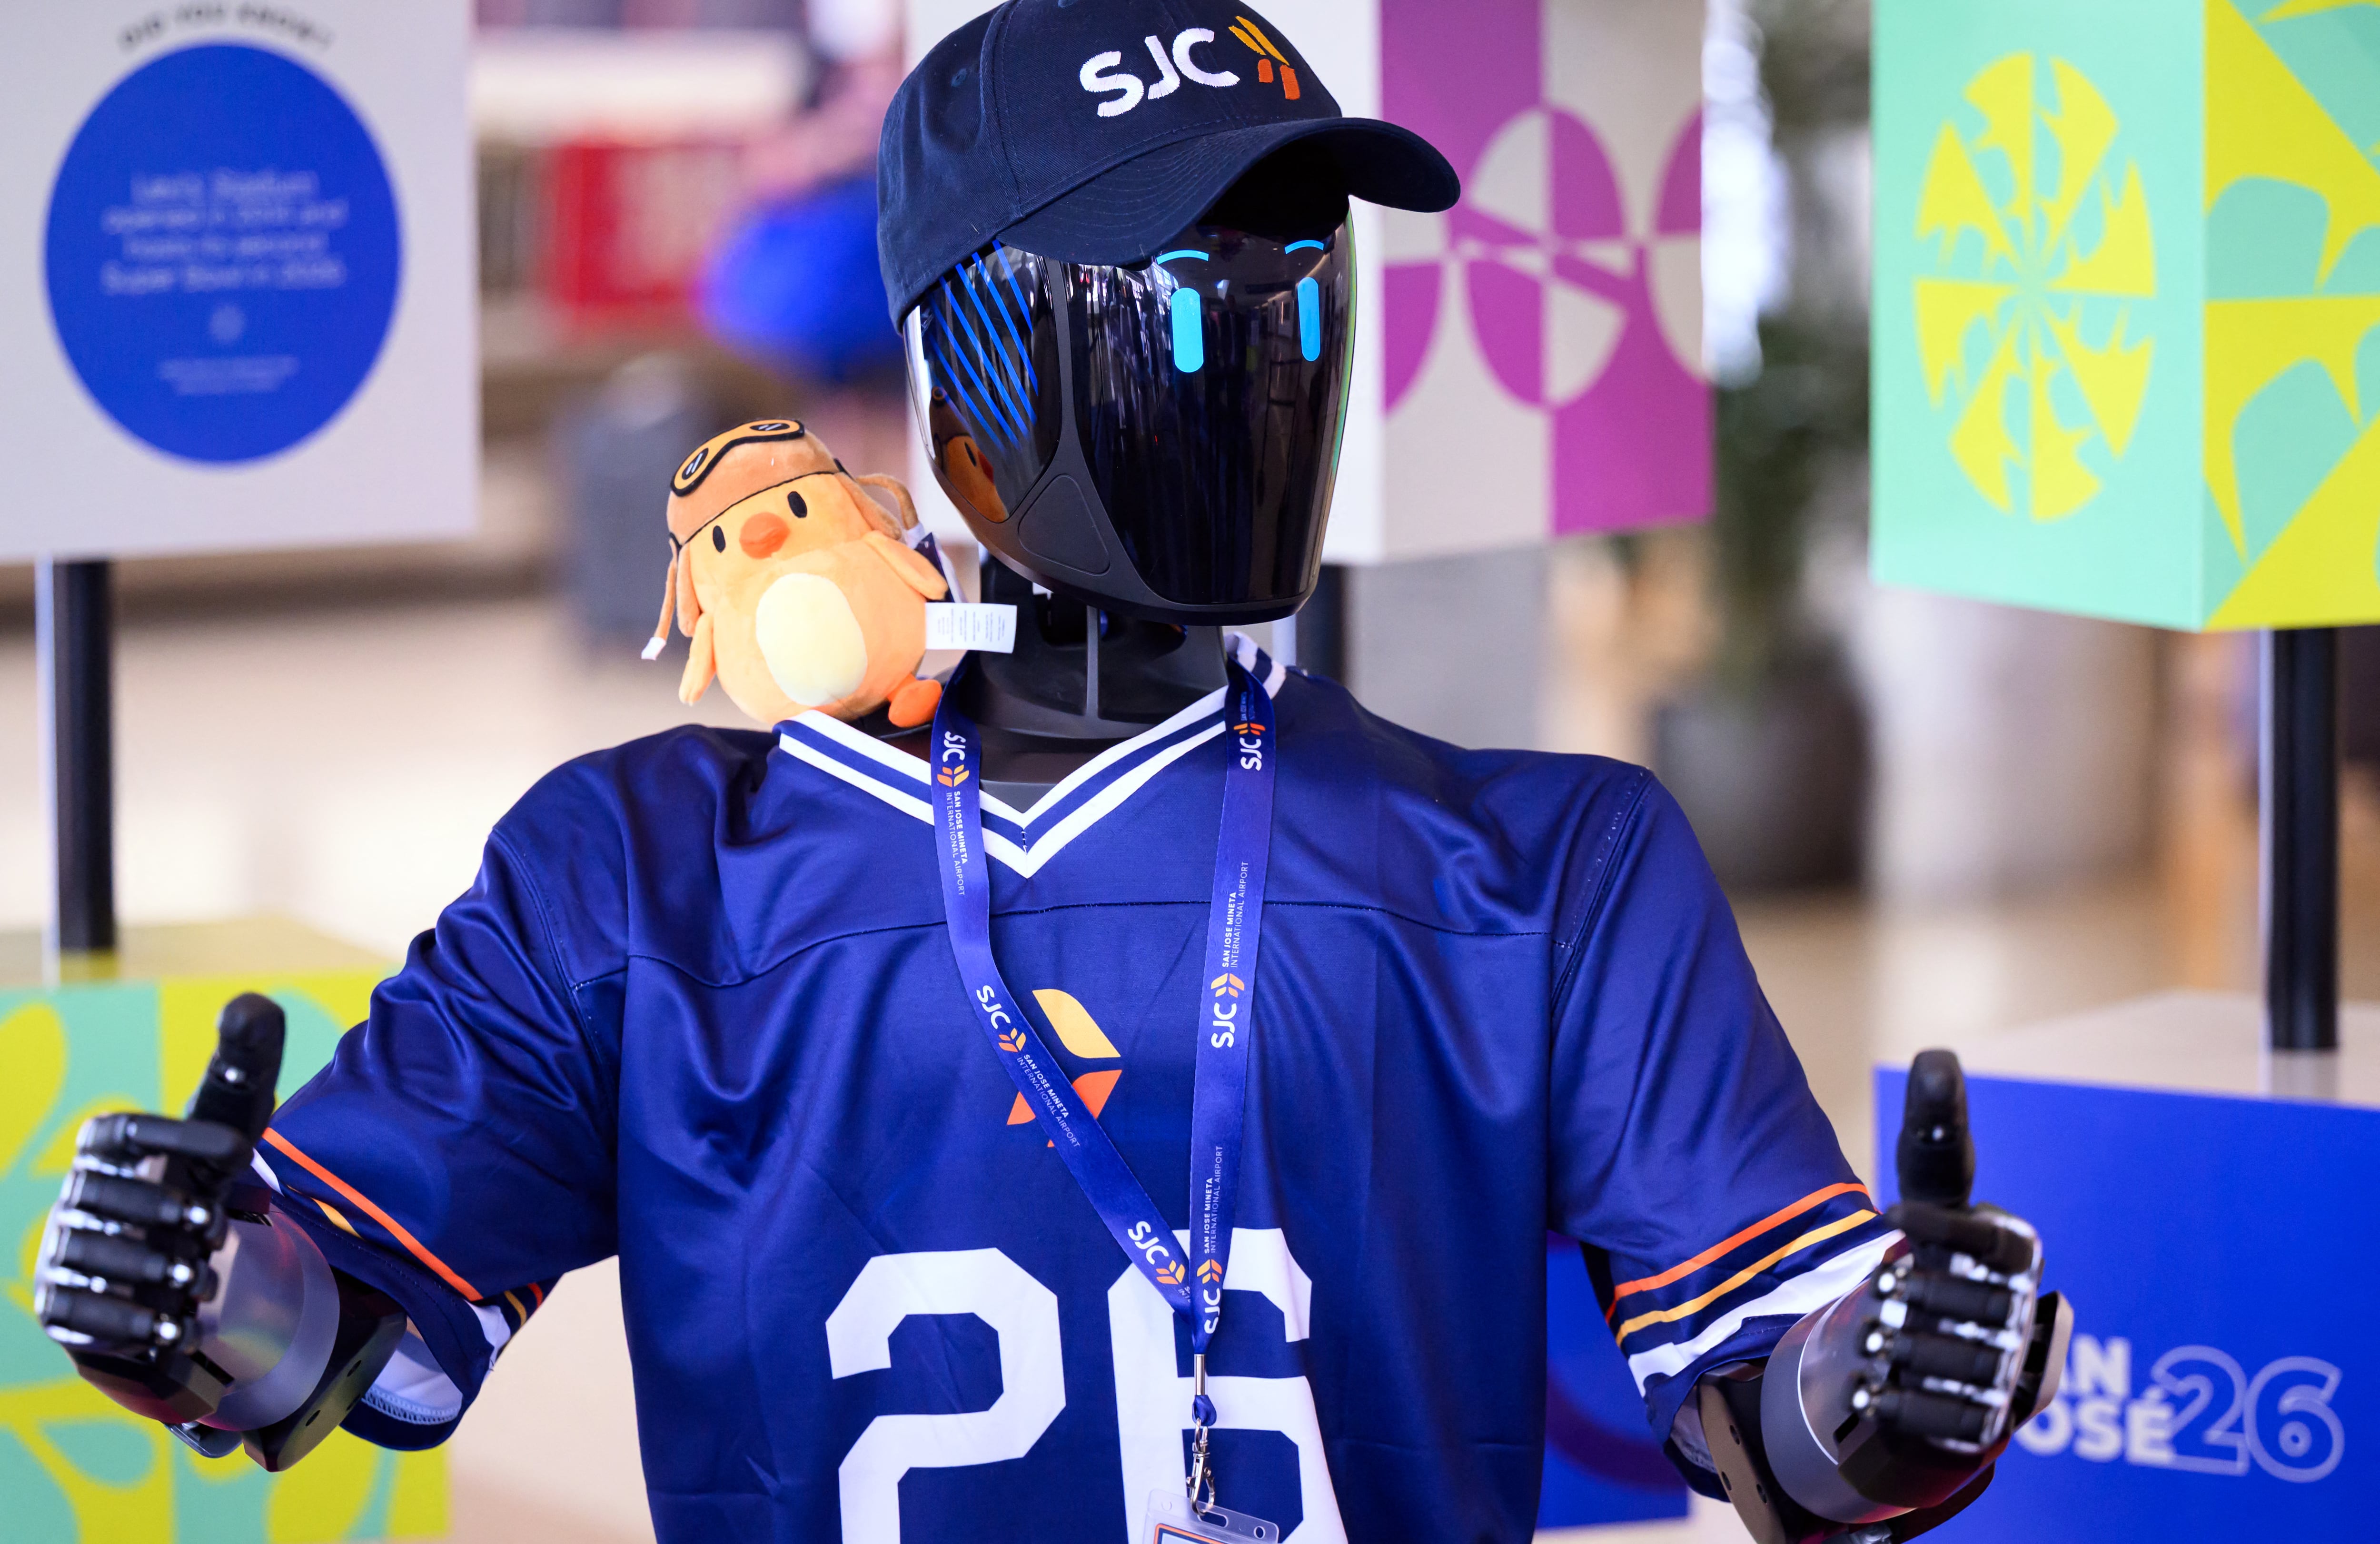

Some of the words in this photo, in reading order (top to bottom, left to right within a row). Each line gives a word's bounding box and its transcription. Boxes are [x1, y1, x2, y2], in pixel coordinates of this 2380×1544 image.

[1080, 28, 1240, 117] SJC
[942, 731, 967, 762] SJC
[1239, 737, 1262, 772] SJC
[955, 809, 963, 830] JOSE
[946, 792, 960, 858] INTERNATIONAL
[953, 860, 965, 896] AIRPORT
[957, 831, 968, 864] MINETA
[1226, 891, 1237, 925] MINETA
[1230, 900, 1244, 968] INTERNATIONAL
[1238, 861, 1249, 898] AIRPORT
[1222, 946, 1230, 968] SAN
[1224, 927, 1233, 951] JOSE
[976, 985, 1011, 1029] SJC
[1210, 1002, 1237, 1048] SJC
[1016, 1057, 1057, 1116] INTERNATIONAL
[1055, 1117, 1081, 1147] AIRPORT
[1023, 1054, 1037, 1070] SAN
[1034, 1070, 1050, 1089] JOSE
[1047, 1089, 1069, 1118] MINETA
[1214, 1146, 1223, 1183] AIRPORT
[1205, 1178, 1213, 1211] MINETA
[1210, 1186, 1220, 1253] INTERNATIONAL
[1128, 1220, 1170, 1266] SJC
[1203, 1287, 1221, 1334] SJC
[825, 1227, 1349, 1544] 26
[2013, 1385, 2176, 1465] OSÉ
[2150, 1344, 2346, 1484] 26
